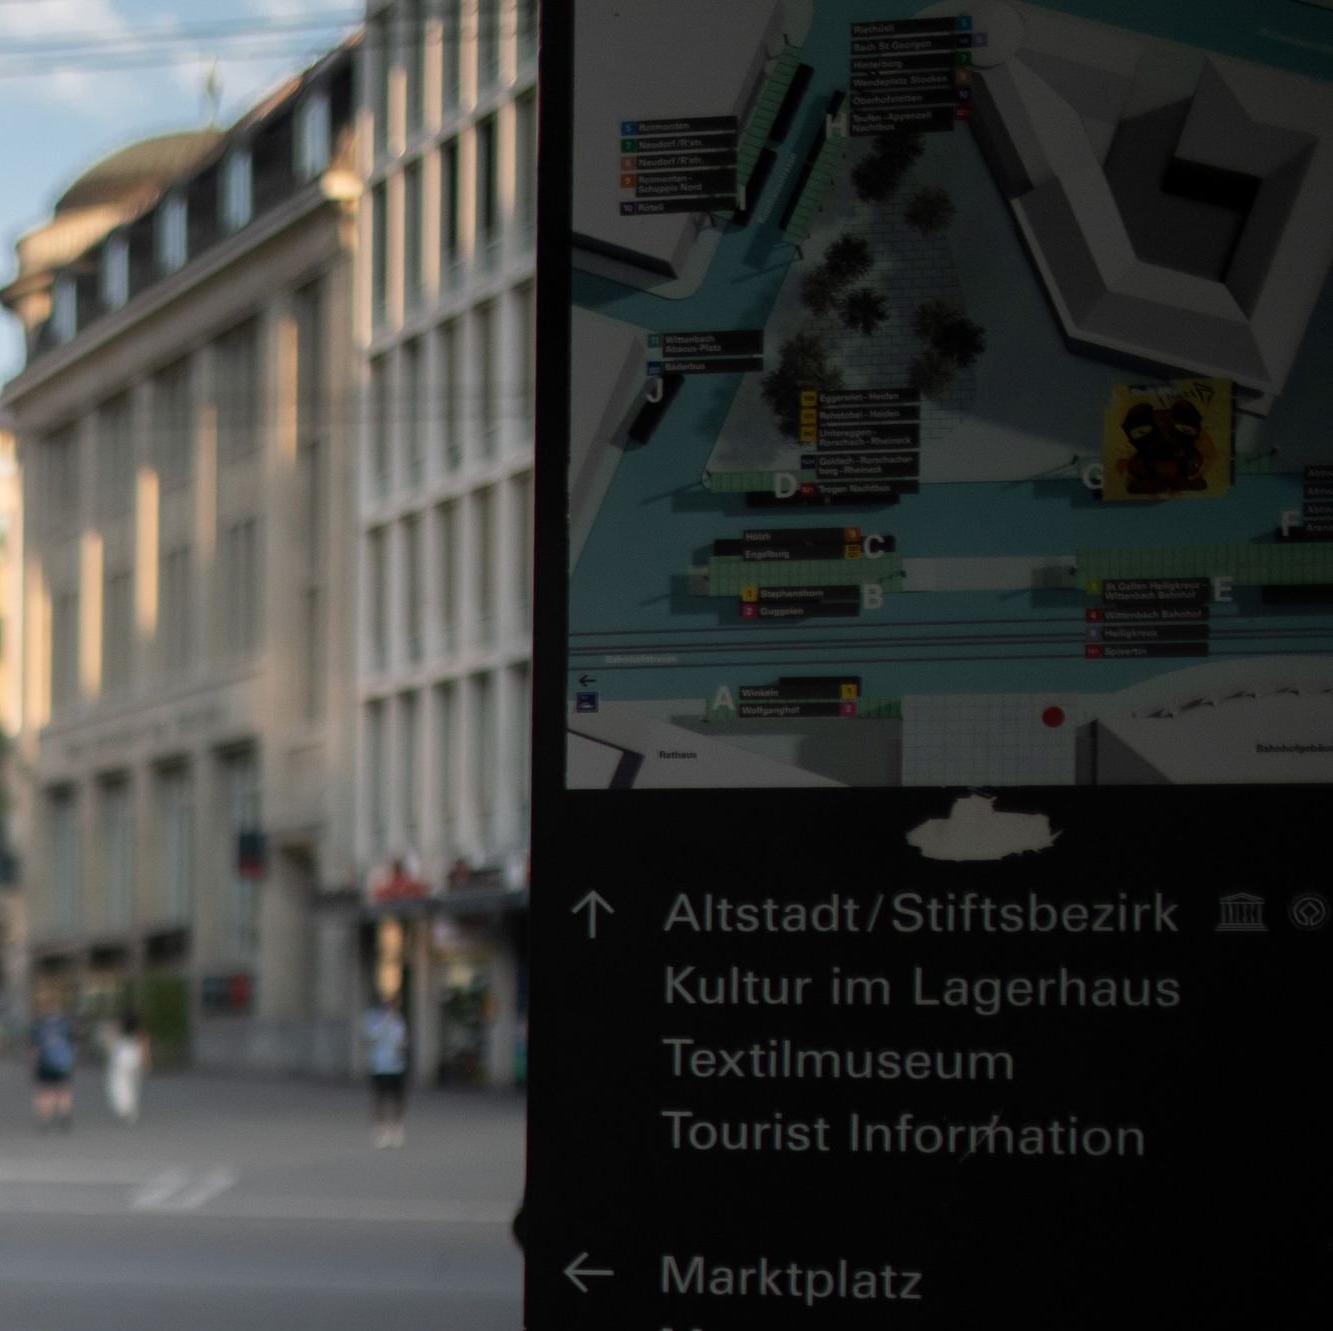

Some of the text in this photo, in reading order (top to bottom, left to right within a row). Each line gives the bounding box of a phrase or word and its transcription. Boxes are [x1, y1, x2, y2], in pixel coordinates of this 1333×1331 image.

[646, 378, 663, 403] J
[775, 473, 797, 498] D
[863, 534, 885, 559] C
[863, 584, 884, 609] B
[1214, 576, 1233, 602] E
[712, 685, 735, 711] A
[659, 751, 696, 759] Rathaus
[665, 966, 1180, 1015] Kultur im Lagerhaus
[661, 1038, 1013, 1079] Textilmuseum
[661, 1110, 1144, 1156] Tourist Information
[661, 1255, 922, 1306] Marktplatz
